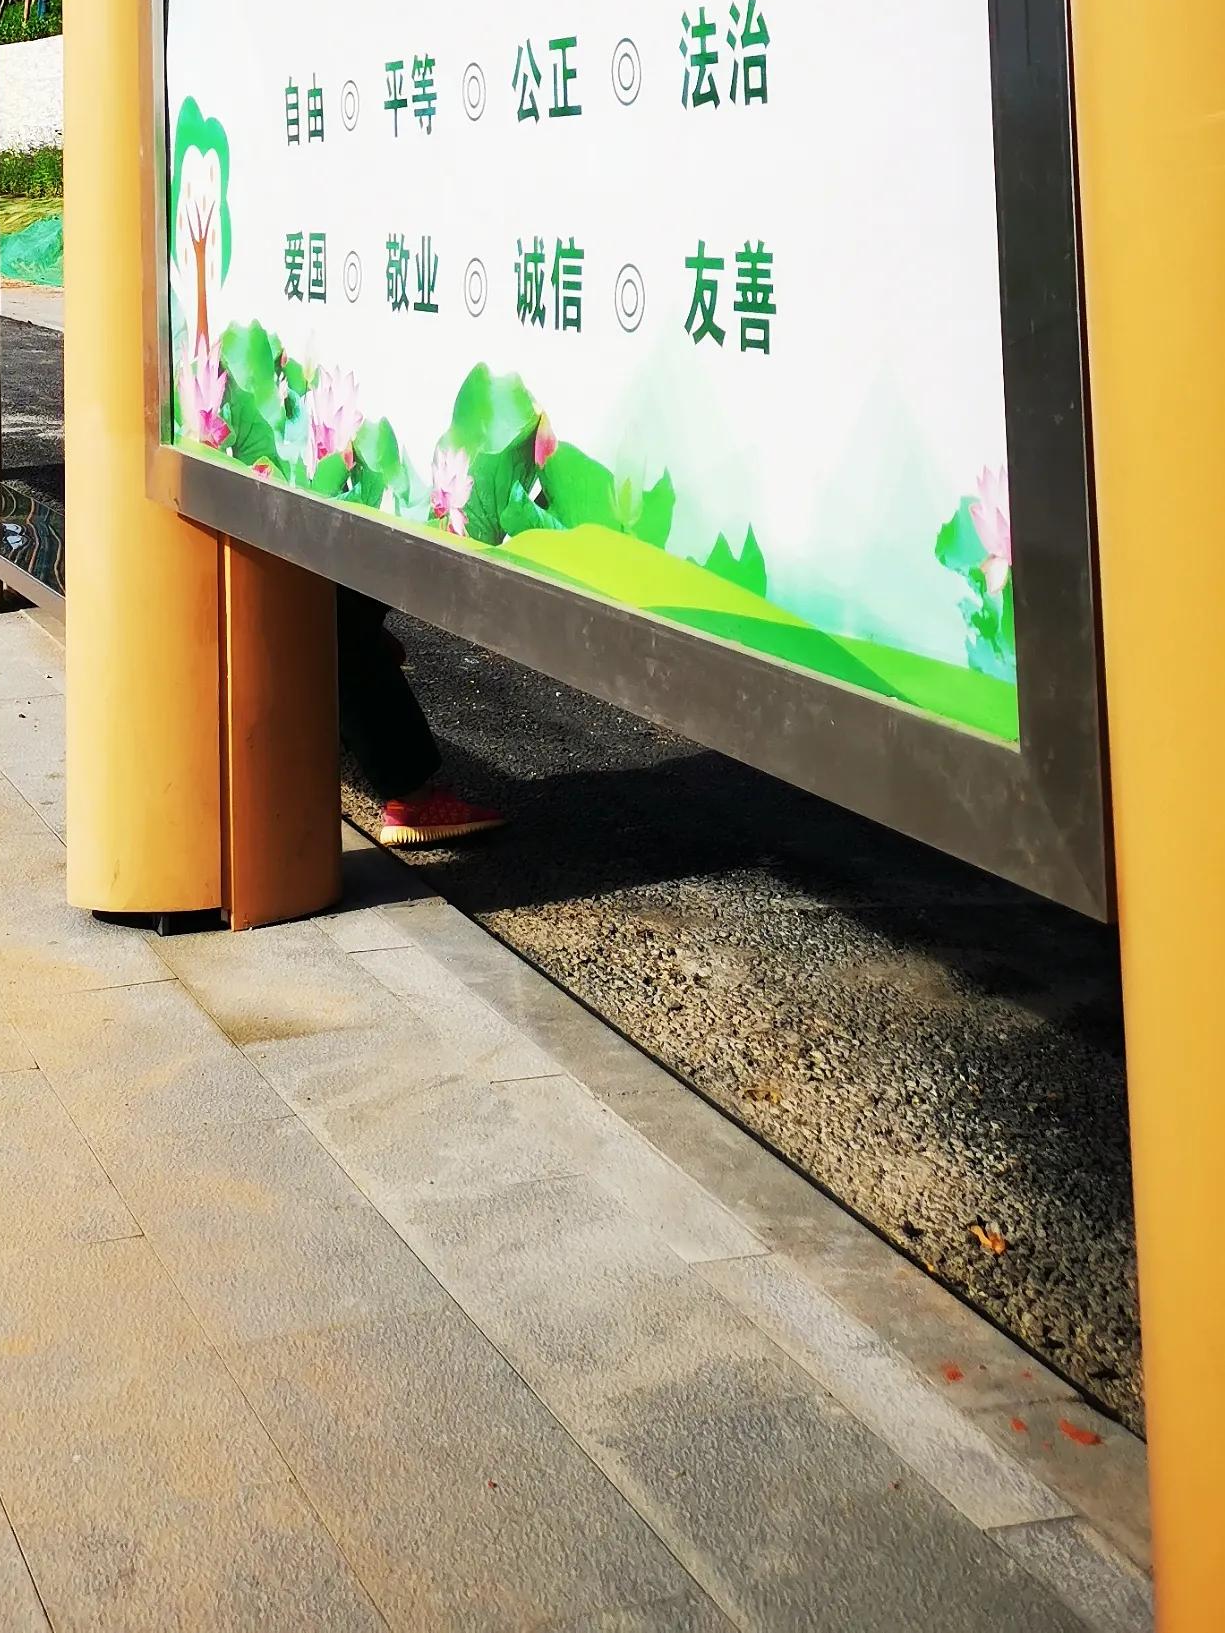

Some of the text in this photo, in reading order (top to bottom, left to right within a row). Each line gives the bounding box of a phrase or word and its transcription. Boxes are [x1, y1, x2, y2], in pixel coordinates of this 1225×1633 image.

[286, 73, 324, 145] 自由
[385, 55, 437, 136] 平等
[512, 37, 581, 122] 公正
[285, 232, 776, 354] 爱国 敬业 诚信 友善
